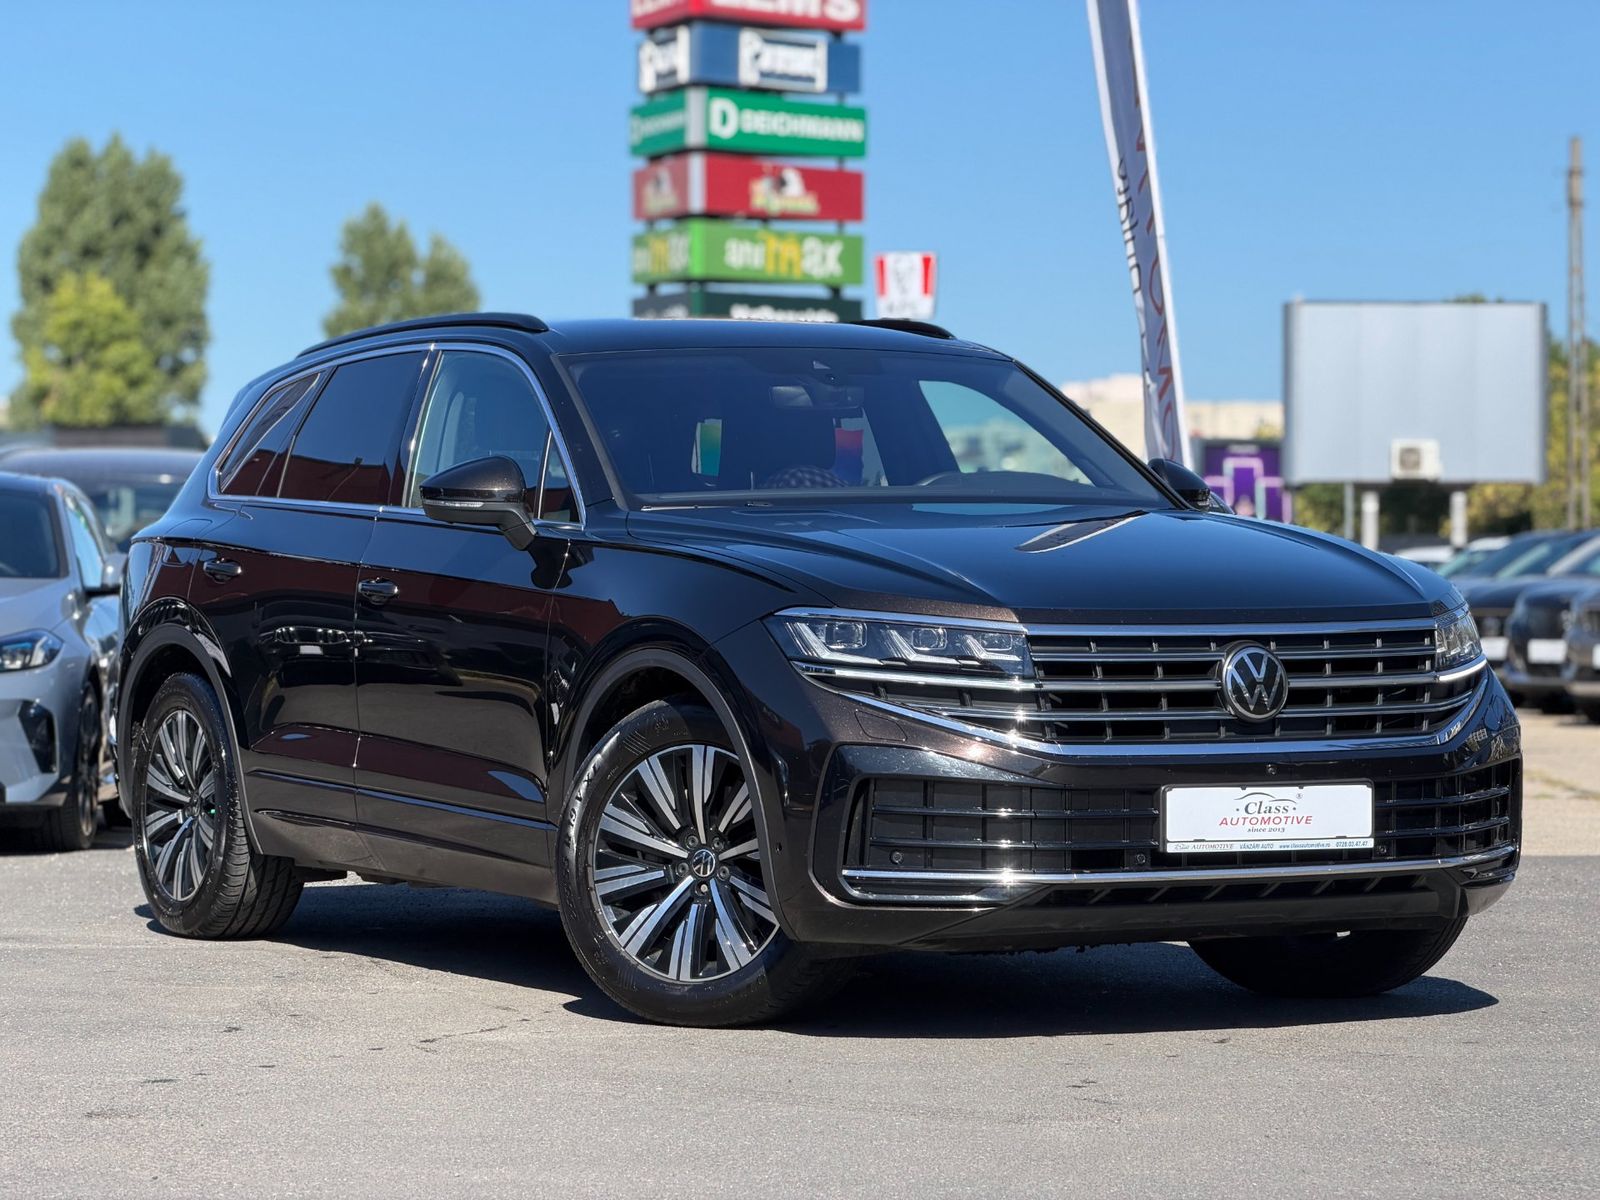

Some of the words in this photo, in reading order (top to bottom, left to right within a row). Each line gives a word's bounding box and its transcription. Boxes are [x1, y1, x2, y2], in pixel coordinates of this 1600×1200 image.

[709, 98, 738, 139] D
[1244, 800, 1289, 815] Class
[1219, 815, 1313, 826] AUTOMOTIVE
